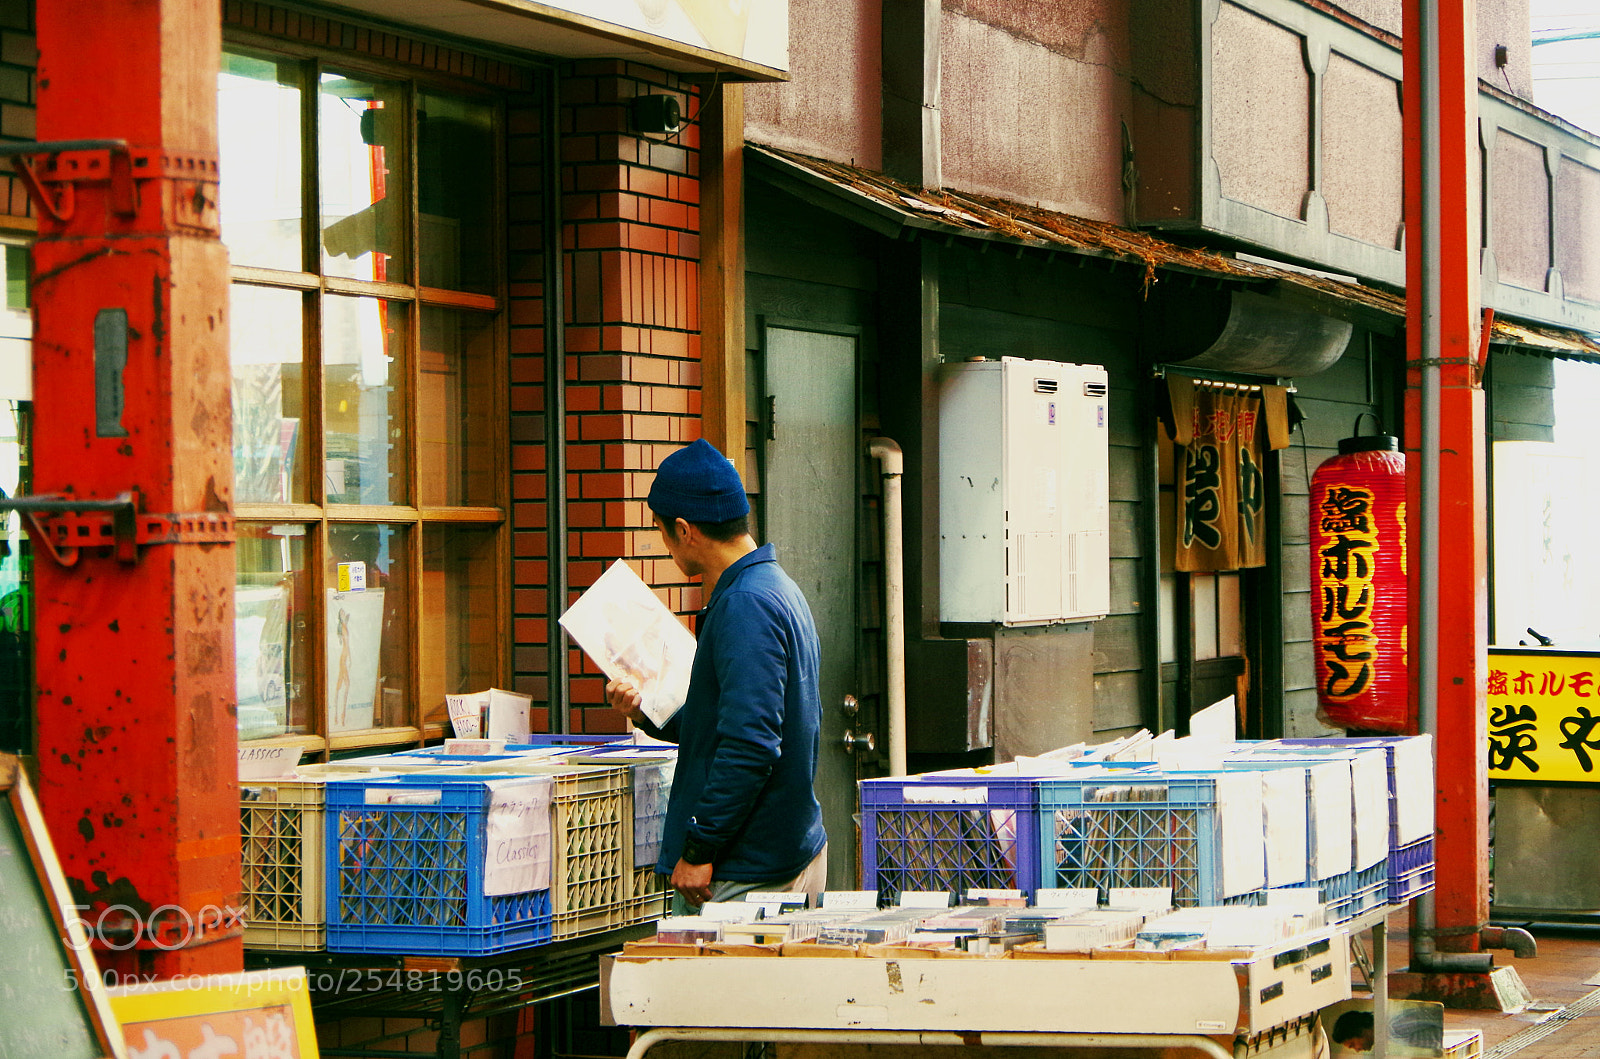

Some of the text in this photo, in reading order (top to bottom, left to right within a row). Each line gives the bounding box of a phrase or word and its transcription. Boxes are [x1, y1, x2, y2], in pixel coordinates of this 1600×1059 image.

[1319, 485, 1377, 699] 塩ホルモン
[1488, 669, 1600, 697] 塩ホルモ
[1488, 704, 1600, 773] 炭や
[237, 748, 284, 761] LASSICS
[496, 838, 539, 865] Classics
